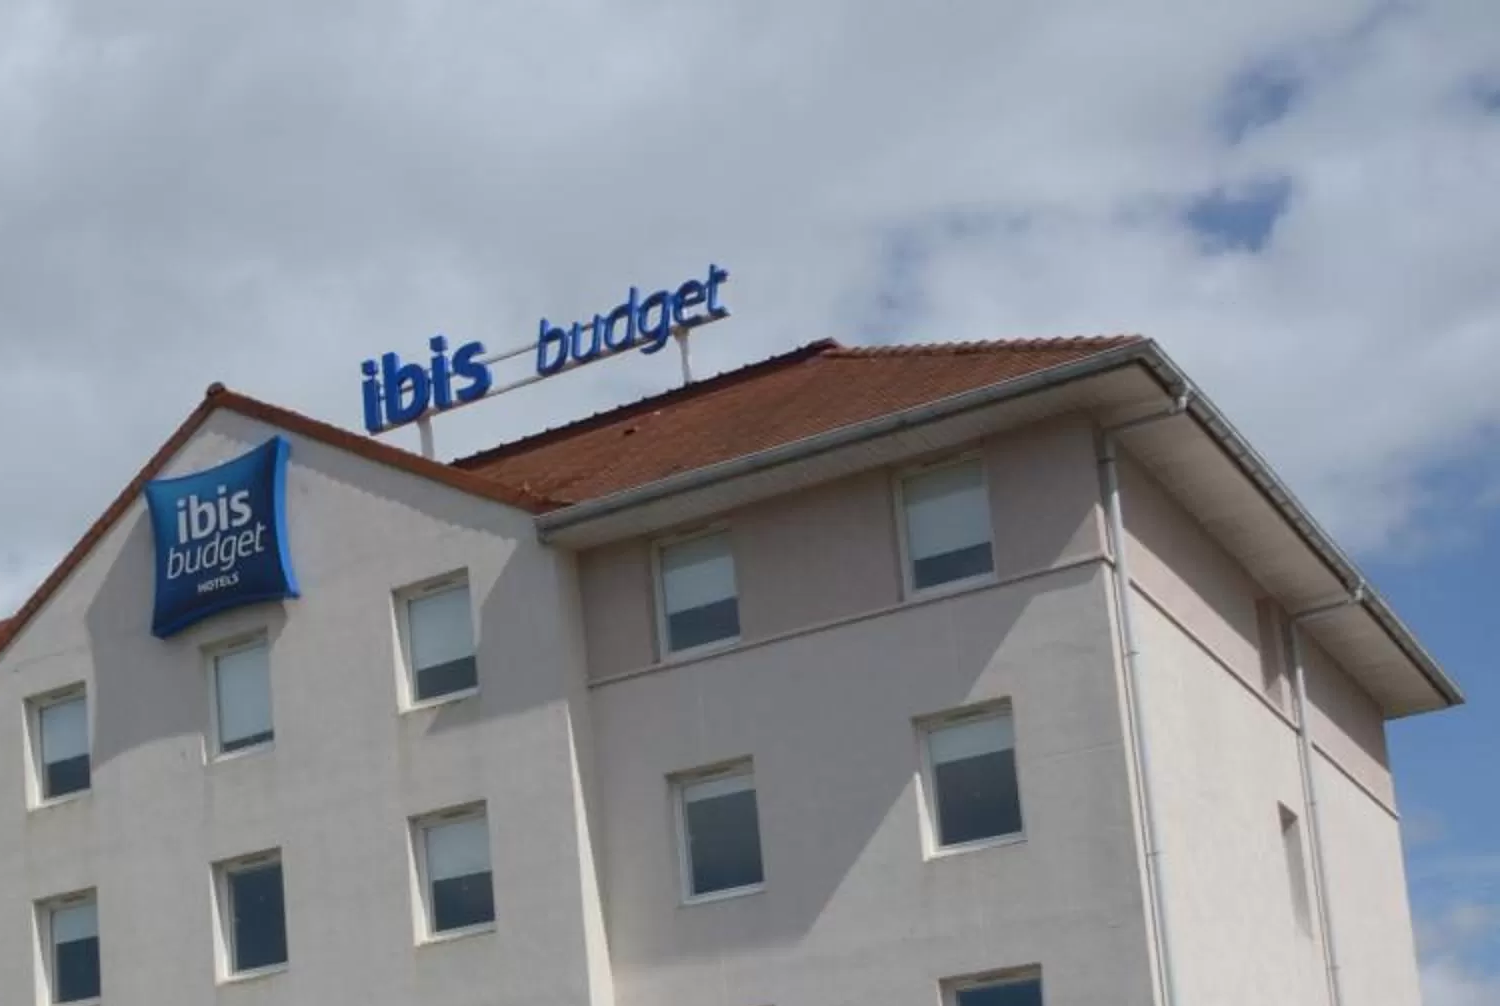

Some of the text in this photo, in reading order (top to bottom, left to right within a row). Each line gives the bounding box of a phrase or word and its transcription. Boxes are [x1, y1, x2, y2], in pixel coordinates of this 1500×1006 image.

[361, 263, 729, 435] ibis budget
[176, 484, 252, 544] ibis
[167, 521, 266, 580] budget
[197, 572, 239, 593] HOTELS
